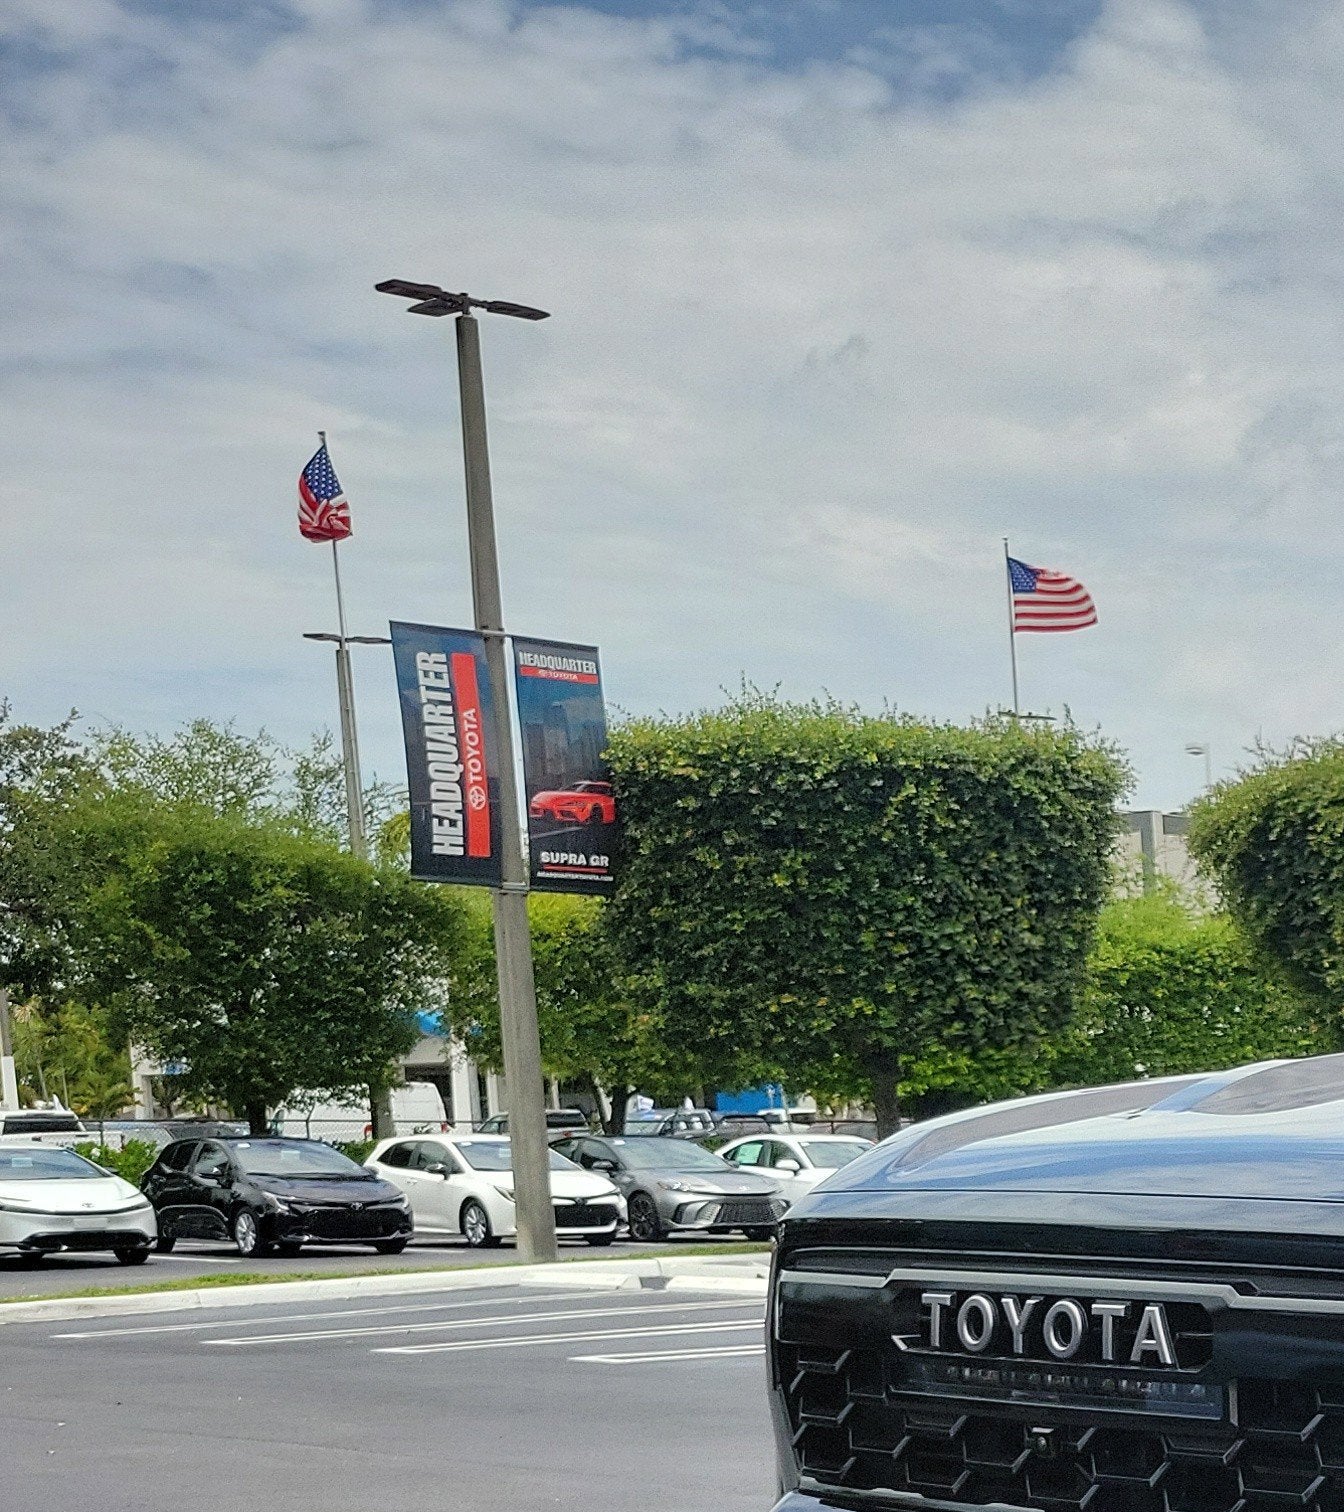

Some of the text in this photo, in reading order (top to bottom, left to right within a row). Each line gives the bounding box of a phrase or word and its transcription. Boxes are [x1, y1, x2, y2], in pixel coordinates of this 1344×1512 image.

[519, 650, 597, 675] HEADQUARTER
[548, 671, 579, 682] TOYOTA
[416, 651, 464, 856] HEADQUARTER
[463, 708, 483, 784] TOYOTA
[541, 851, 610, 868] SUPRA GR
[921, 1291, 1178, 1368] TOYOTA
